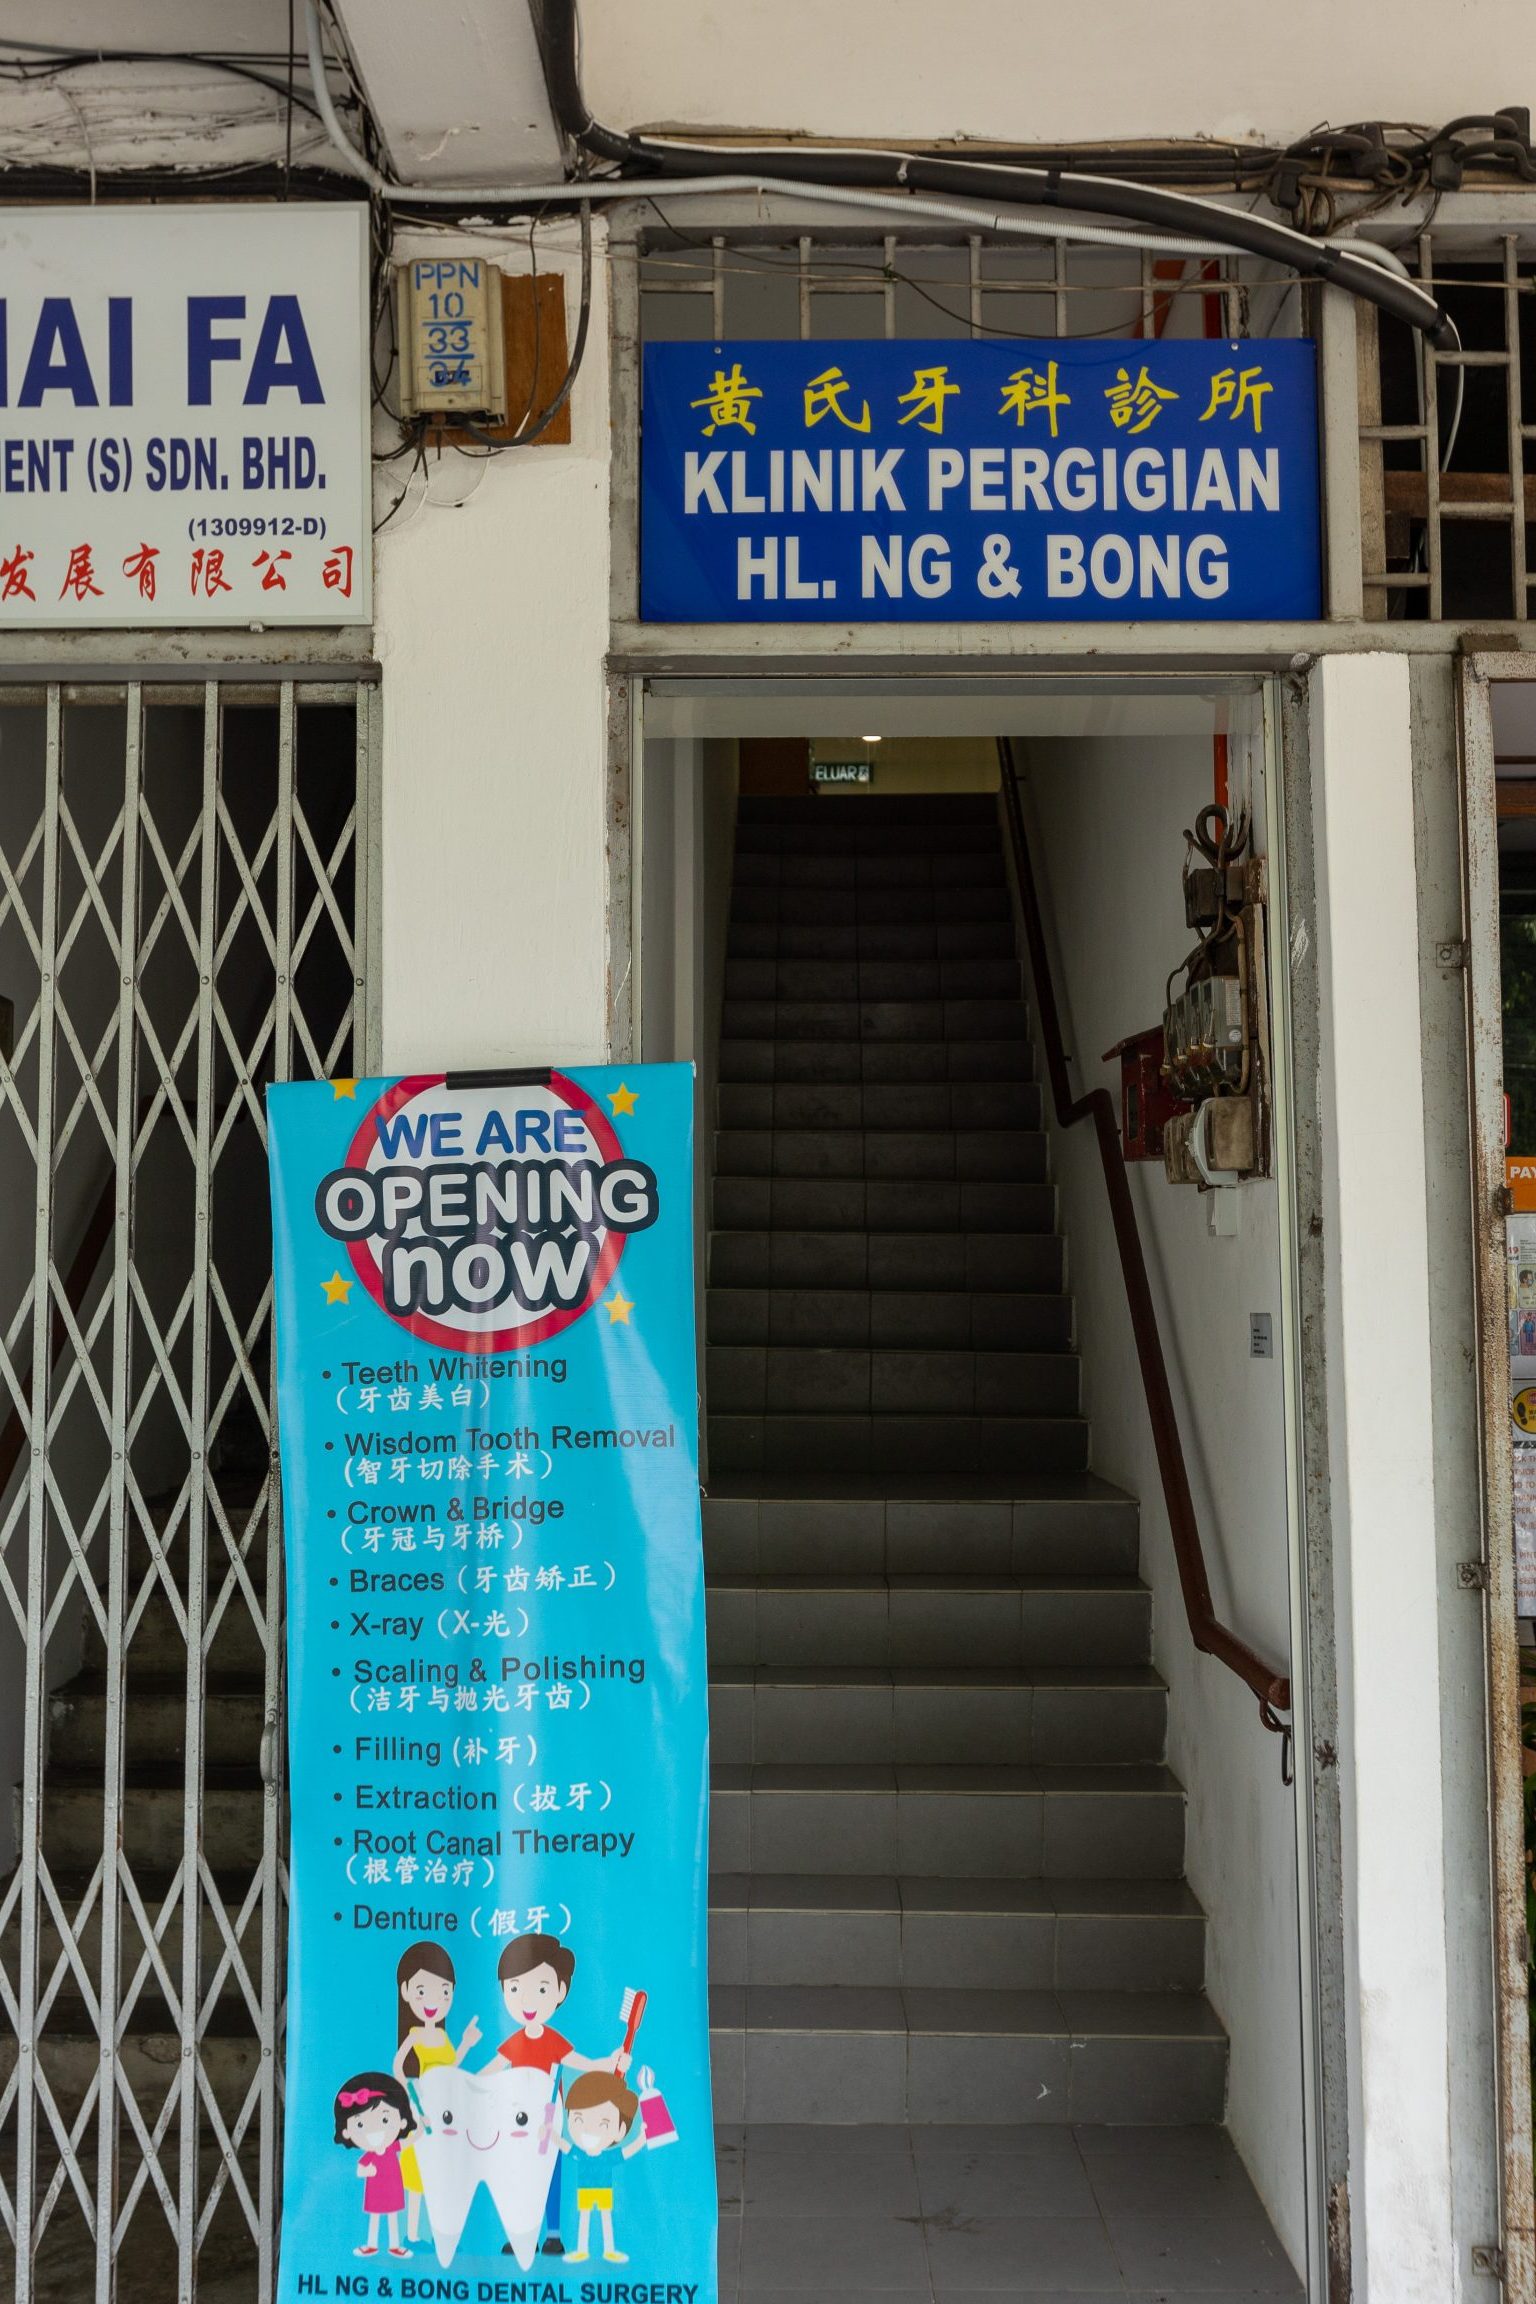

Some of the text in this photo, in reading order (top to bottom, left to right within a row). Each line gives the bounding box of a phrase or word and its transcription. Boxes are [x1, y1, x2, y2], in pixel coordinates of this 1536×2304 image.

[415, 262, 479, 290] PPN
[428, 292, 464, 319] 10
[0, 295, 326, 408] AI FA
[428, 326, 470, 353] 33
[87, 437, 133, 492] (S)
[146, 436, 229, 491] SDN.
[242, 436, 326, 490] BHD.
[684, 447, 1280, 514] KLINIK PERGIGIAN
[188, 517, 327, 540] (1309912-D)
[0, 543, 354, 602] 发展有限公司
[737, 534, 1229, 600] HL. NG & BONG
[375, 1109, 588, 1160] WE ARE
[322, 1166, 652, 1235] OPENING
[341, 1355, 567, 1385] Teeth Whitening
[336, 1380, 490, 1415] (牙齿美白)
[344, 1425, 675, 1456] Wisdom Tooth Removal
[344, 1451, 552, 1487] (智牙切除手术)
[347, 1496, 565, 1525] Crown & Bridge
[341, 1520, 523, 1554] (牙冠与牙桥)
[350, 1561, 616, 1594] Braces (牙齿矫正)
[350, 1607, 530, 1641] X-ray (X-光)
[354, 1654, 645, 1688] Scaling & Polishing
[350, 1680, 591, 1714] (洁牙与抛光牙齿)
[355, 1735, 537, 1768] Filling (补牙)
[355, 1781, 611, 1814] Extraction (拔牙)
[353, 1829, 635, 1858] Root Canal Therapy
[346, 1855, 495, 1888] (根管治疗)
[353, 1904, 571, 1938] Denture (假牙)
[298, 2273, 699, 2304] HL NG & BONG DENTAL SURGERY
